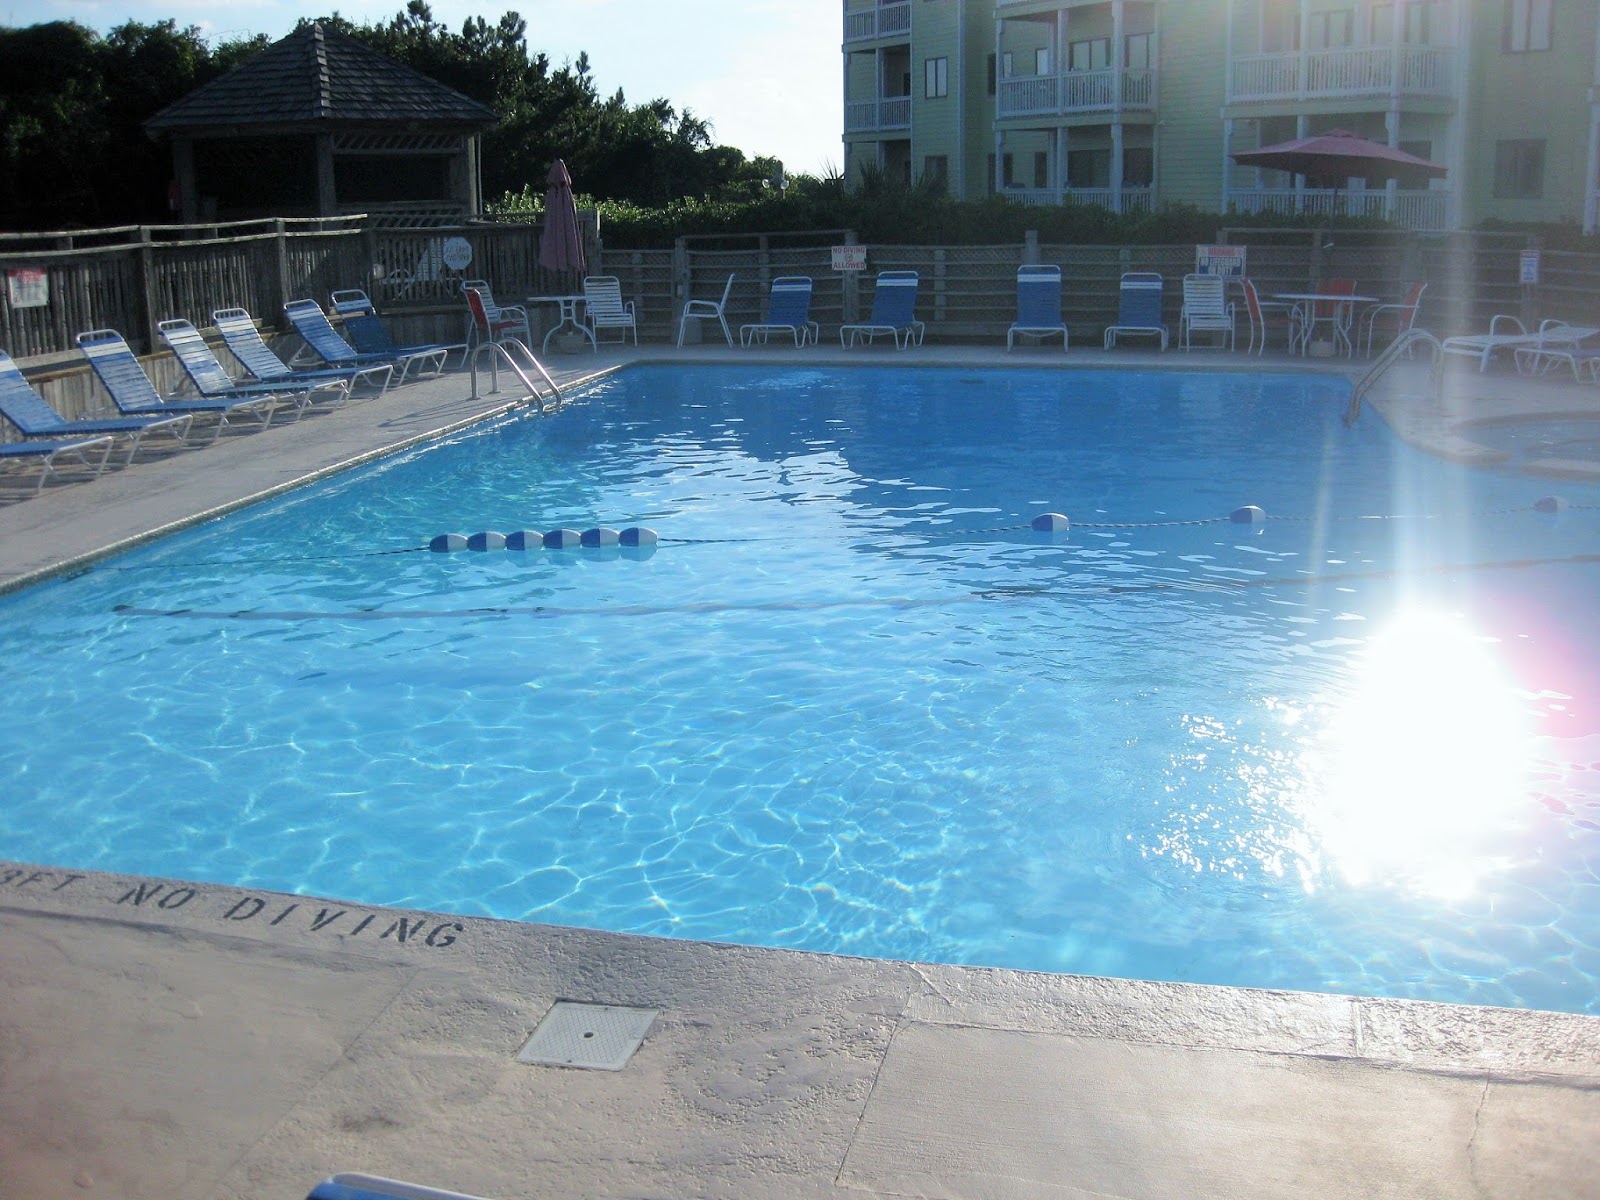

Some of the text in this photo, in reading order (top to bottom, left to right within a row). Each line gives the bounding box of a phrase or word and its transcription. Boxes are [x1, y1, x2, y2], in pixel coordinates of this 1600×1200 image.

[832, 246, 866, 254] NO DIVING
[117, 882, 196, 909] NO
[222, 897, 465, 948] DIVING
